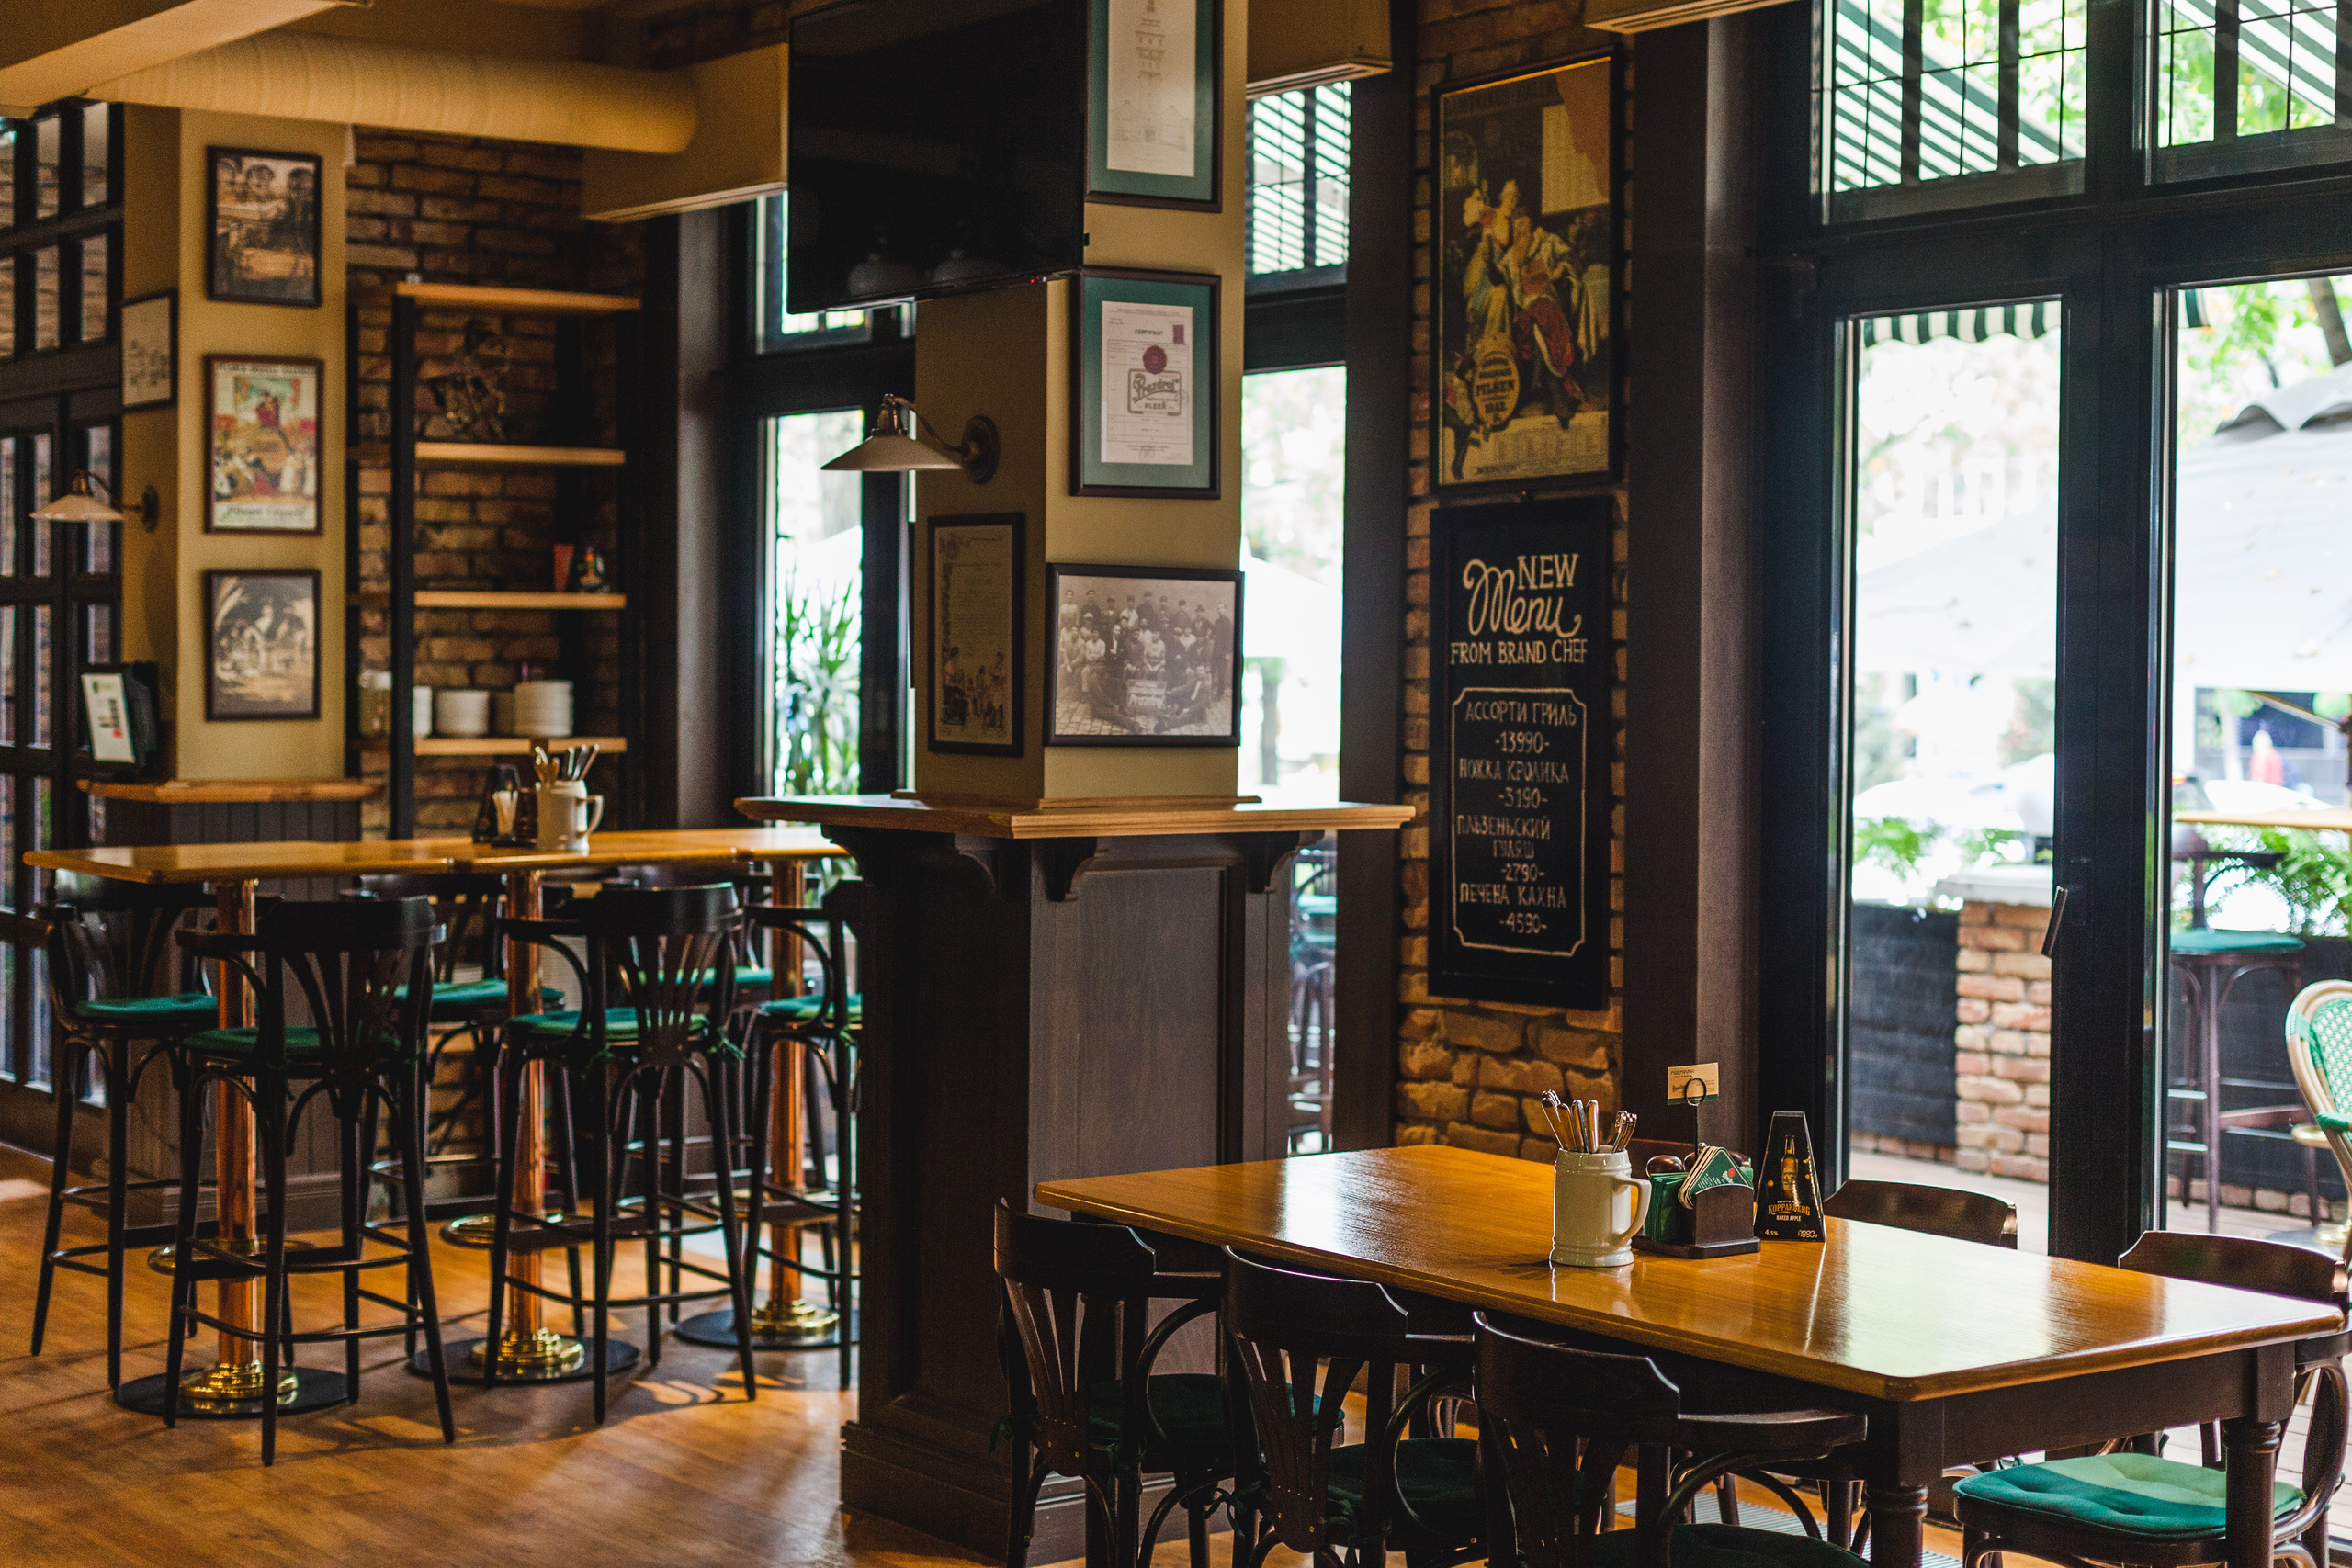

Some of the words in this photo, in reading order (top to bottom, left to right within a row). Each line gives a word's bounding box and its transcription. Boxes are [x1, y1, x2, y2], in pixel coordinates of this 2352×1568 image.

[1517, 553, 1579, 591] NEW
[1463, 558, 1582, 637] Menu
[1451, 642, 1492, 665] FROM
[1498, 641, 1547, 664] BRAND
[1552, 638, 1588, 663] CHEF
[1465, 700, 1527, 723] АССОРТИ
[1532, 703, 1577, 727] ГРИЛЬ
